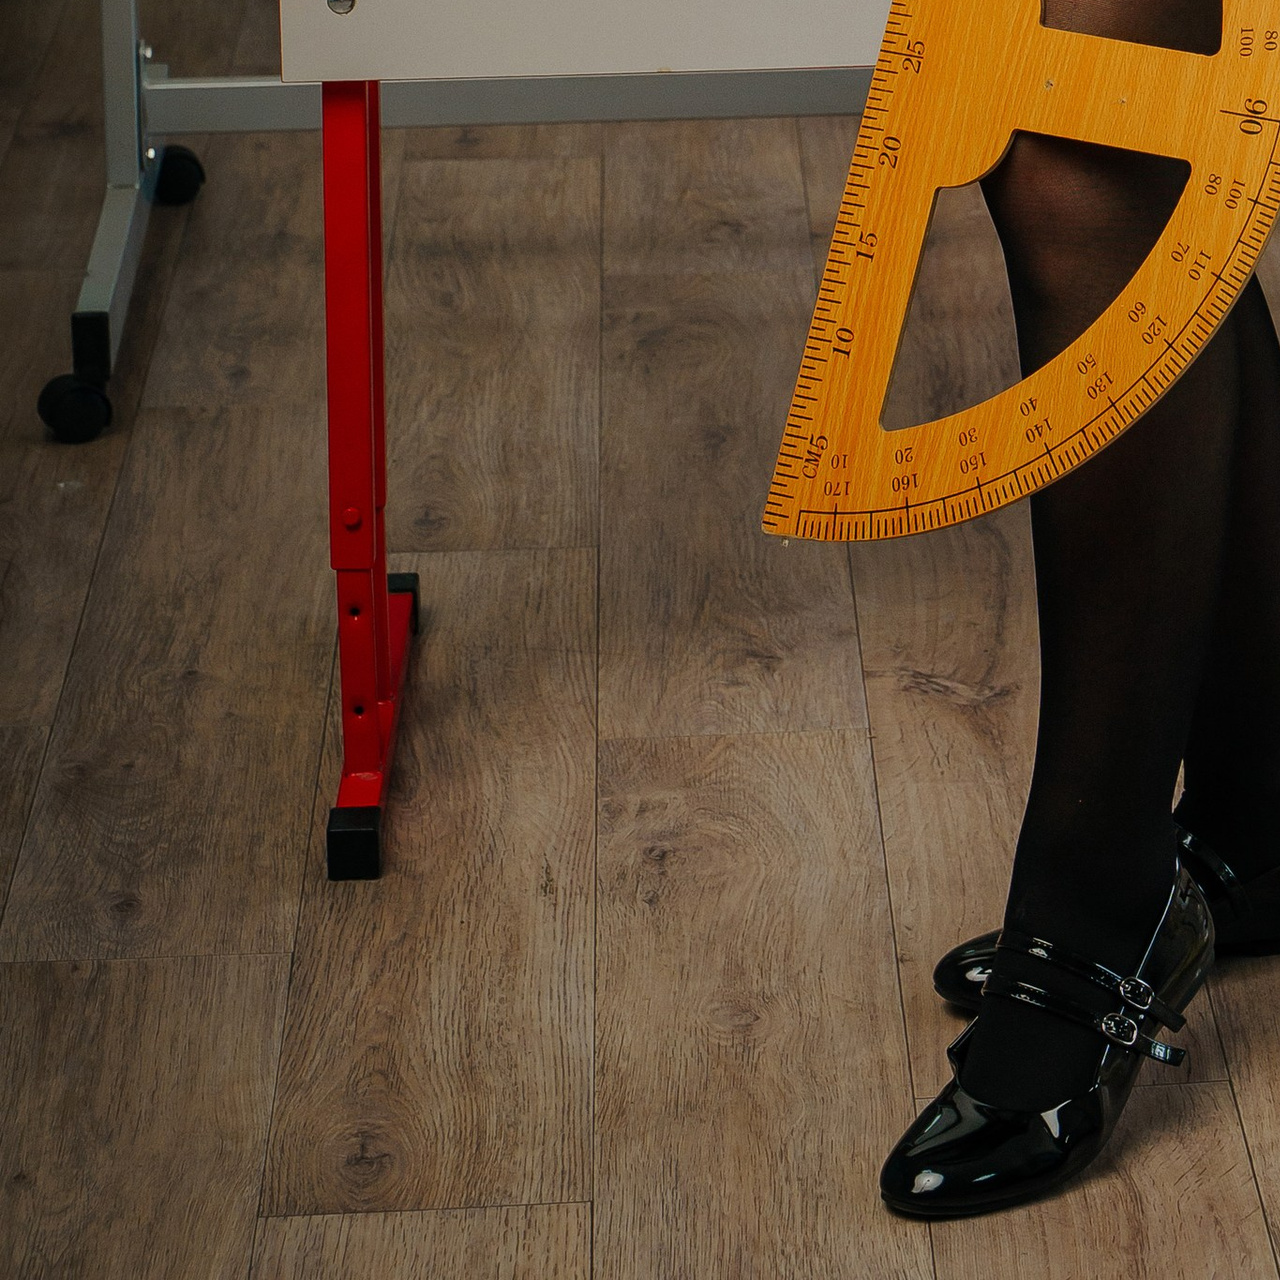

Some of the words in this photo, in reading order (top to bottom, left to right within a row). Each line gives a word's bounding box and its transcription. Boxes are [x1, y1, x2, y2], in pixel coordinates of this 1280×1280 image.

[1240, 28, 1254, 57] 100
[1264, 31, 1278, 51] 80
[903, 39, 926, 74] 25
[1239, 98, 1268, 135] 90
[878, 136, 903, 169] 20
[1205, 173, 1222, 195] 80
[1225, 178, 1246, 210] 100
[856, 231, 878, 264] 15
[1170, 241, 1190, 263] 70
[1188, 250, 1212, 282] 110
[1128, 301, 1147, 322] 60
[1141, 315, 1168, 345] 120
[832, 327, 855, 359] 10
[1077, 353, 1097, 375] 50
[1086, 371, 1114, 400] 130
[1020, 396, 1039, 417] 40
[959, 428, 978, 446] 30
[1025, 417, 1054, 443] 140
[831, 454, 848, 469] 10
[895, 447, 913, 464] 20
[960, 452, 988, 475] 150
[824, 481, 850, 496] 170
[892, 473, 919, 492] 160
